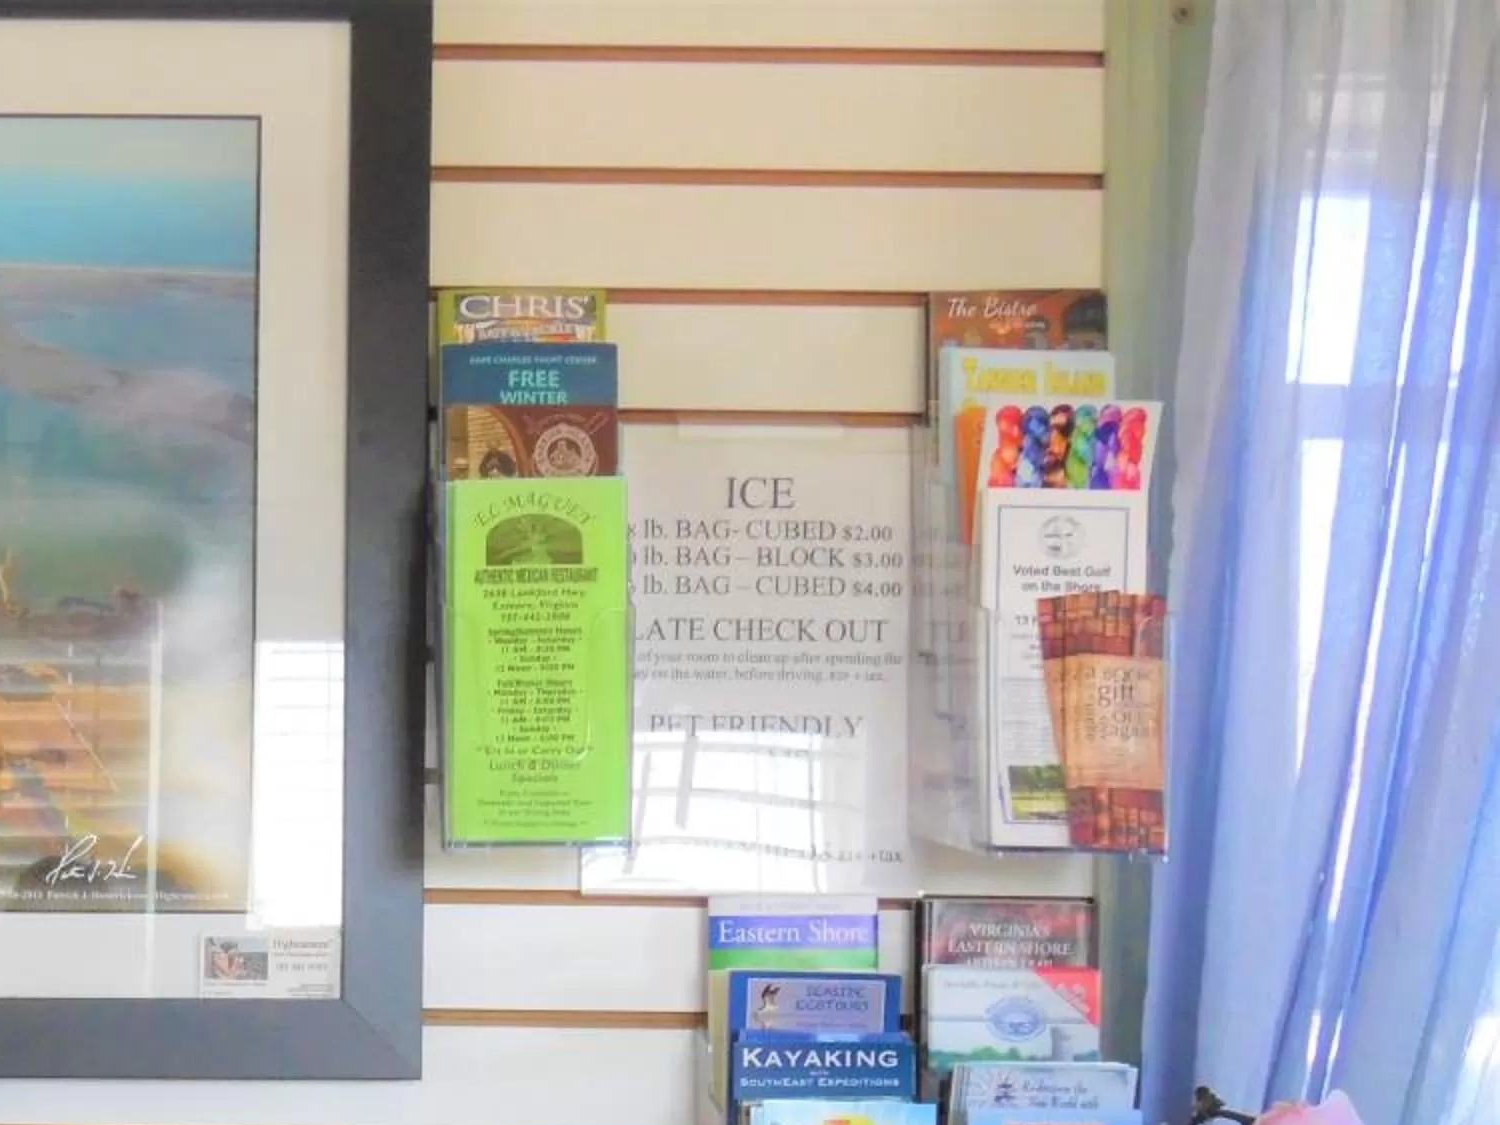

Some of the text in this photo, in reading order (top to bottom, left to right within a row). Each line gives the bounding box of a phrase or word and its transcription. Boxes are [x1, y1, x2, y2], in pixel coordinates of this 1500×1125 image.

[459, 292, 590, 320] CHRIS'
[946, 297, 977, 318] The
[507, 369, 561, 389] FREE
[499, 390, 568, 405] WINTER
[726, 477, 796, 509] ICE
[643, 519, 669, 540] lb.
[745, 519, 836, 541] CUBED
[842, 524, 893, 542] $2.00
[643, 545, 903, 569] lb. BAG BLOCK $3.00
[642, 574, 903, 598] lb. BAG CUBED $4.00
[713, 617, 819, 642] CHECK
[825, 618, 890, 642] OUT
[711, 715, 864, 739] FRIENDLY
[718, 917, 870, 944] Eastern Shore
[742, 1047, 900, 1068] KAYAKING
